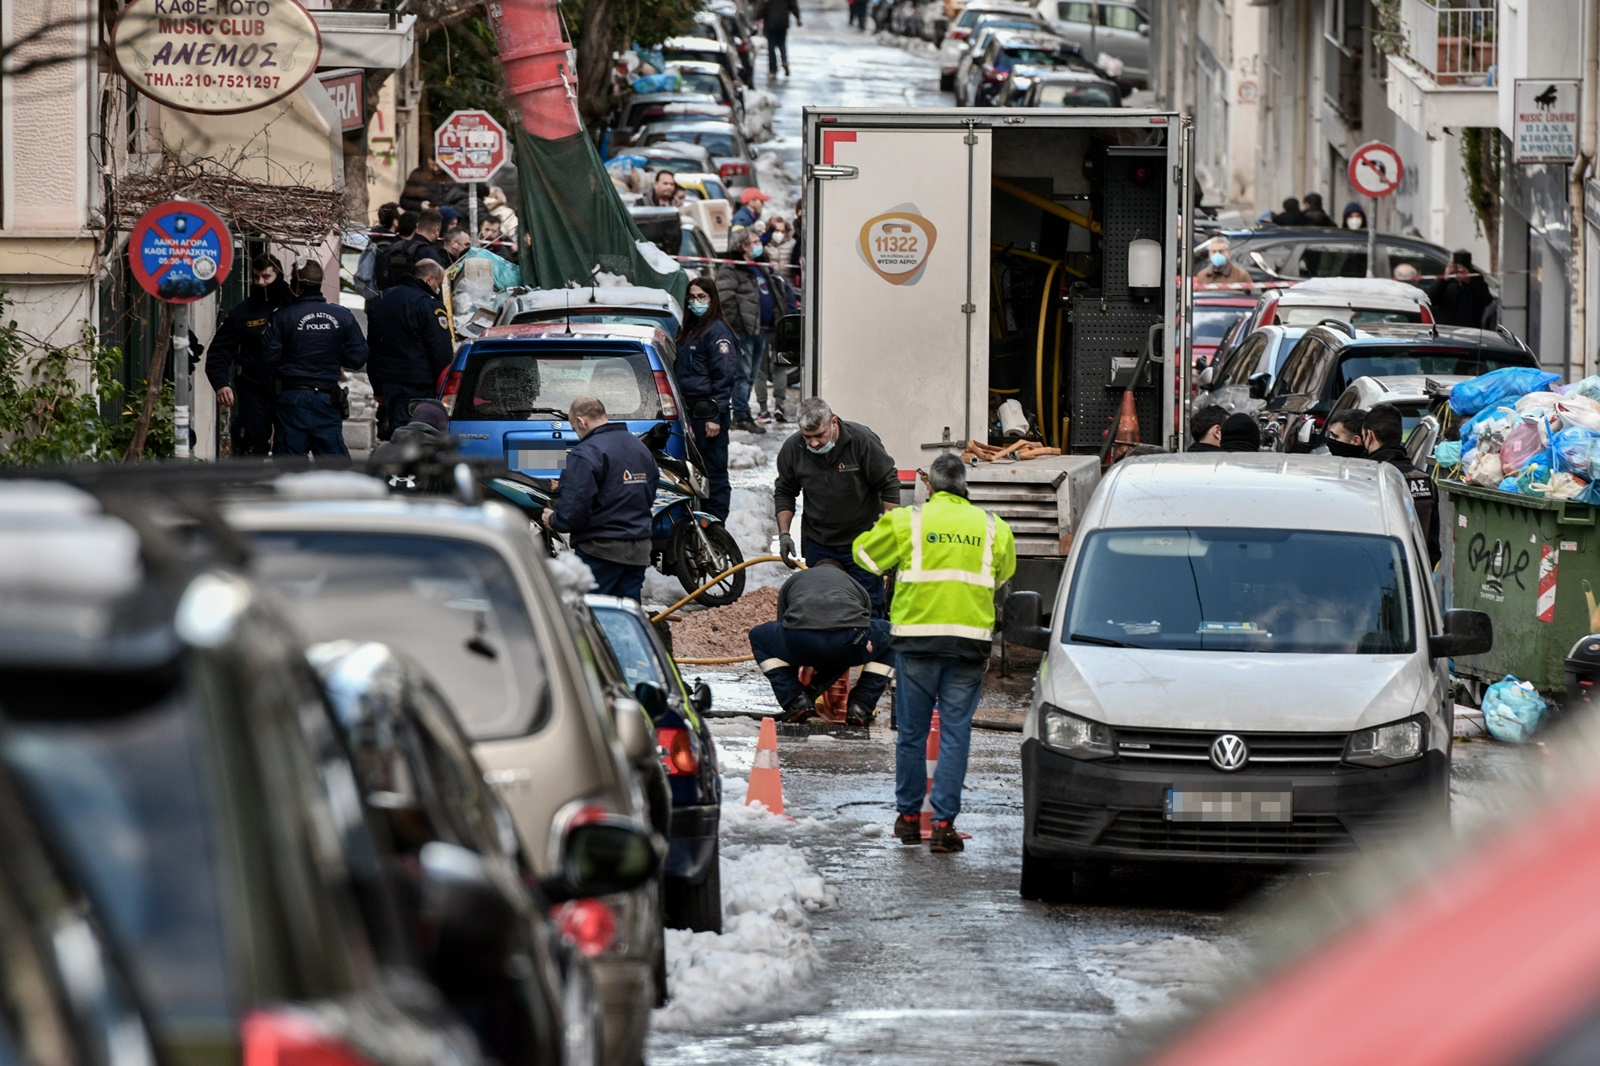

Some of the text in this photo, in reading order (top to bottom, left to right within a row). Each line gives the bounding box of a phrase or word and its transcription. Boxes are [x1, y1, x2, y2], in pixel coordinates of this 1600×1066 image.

[158, 18, 265, 36] MUSIC CLUB
[152, 41, 278, 68] ΑΝΕΜΟΣ
[1519, 113, 1576, 123] MUSIC LOVERS
[1525, 124, 1568, 132] ΠΙΑΝΑ
[180, 239, 207, 247] ΑΓΟΡΑ
[875, 236, 918, 252] 11322
[144, 247, 217, 257] ΚΑΘΕ ΠΑΡΑΣΚΕΥΗ
[938, 533, 982, 547] ΕΥΔΑΠ
